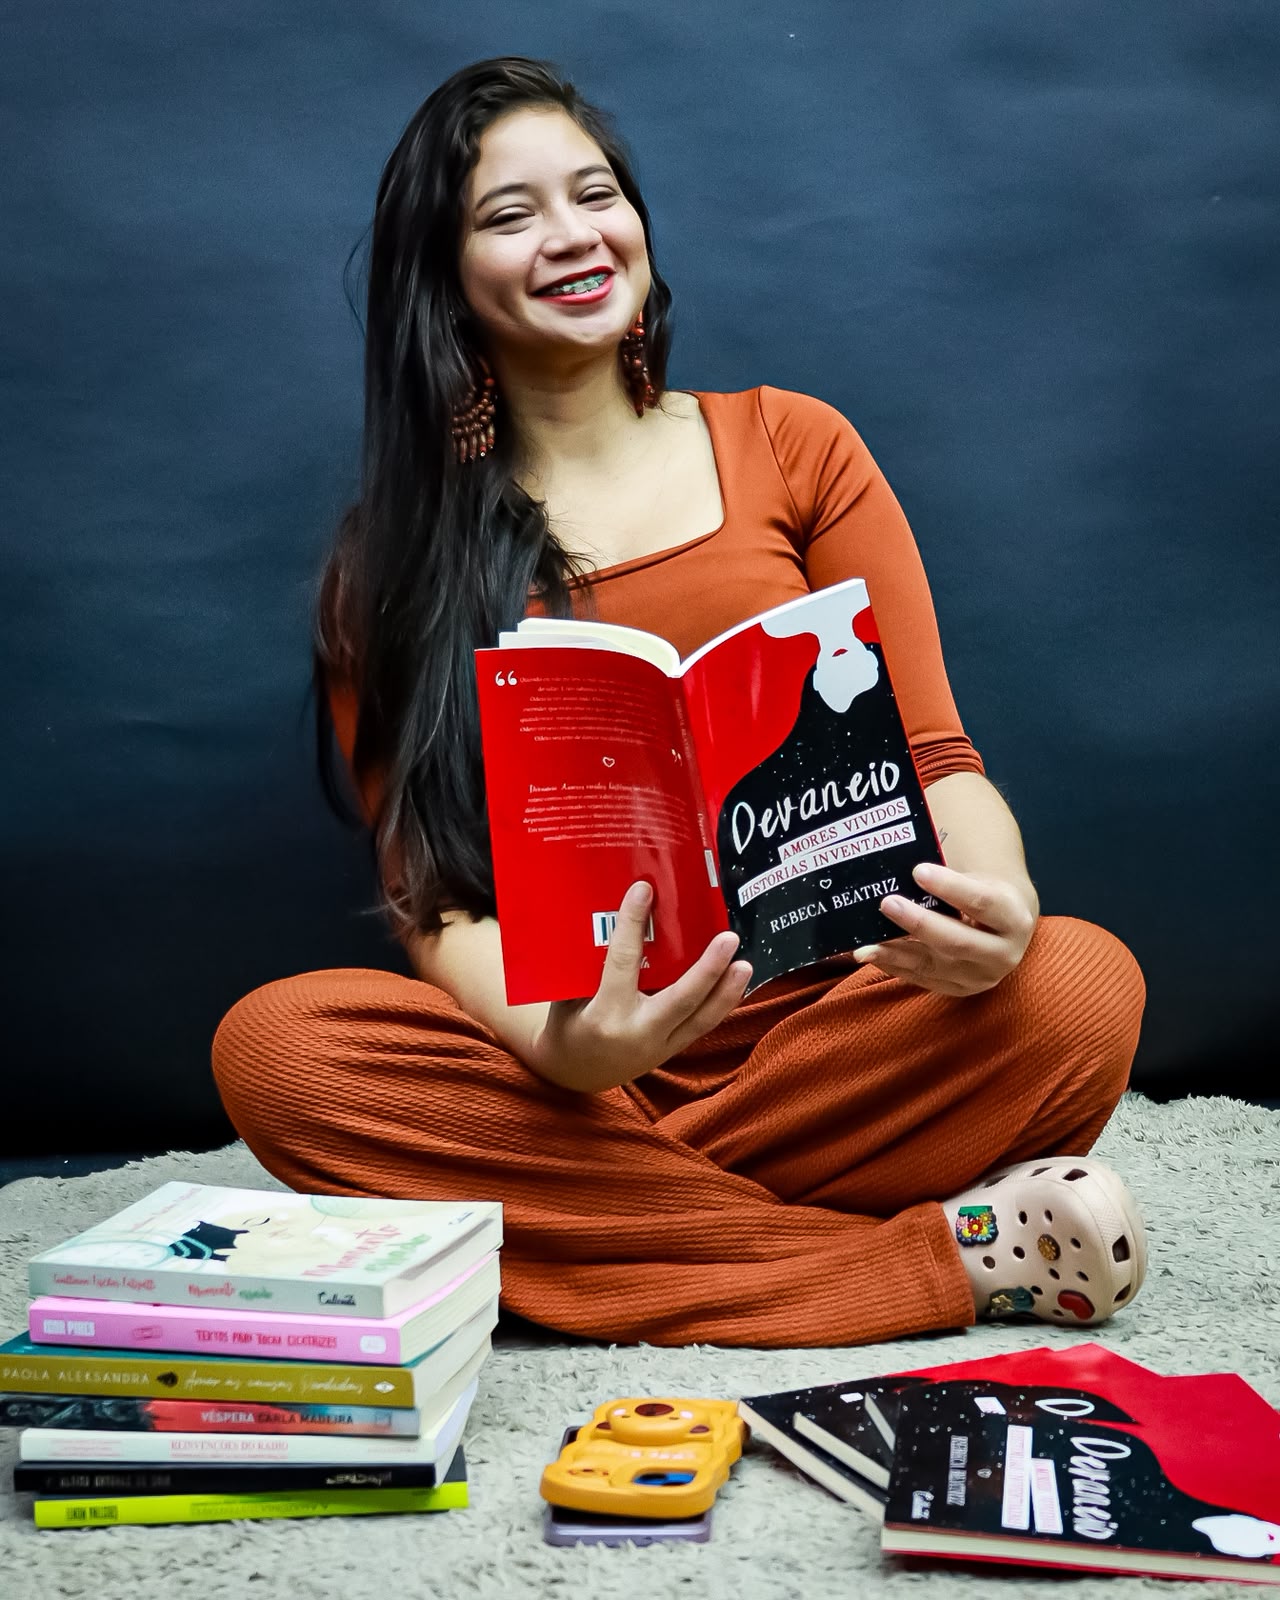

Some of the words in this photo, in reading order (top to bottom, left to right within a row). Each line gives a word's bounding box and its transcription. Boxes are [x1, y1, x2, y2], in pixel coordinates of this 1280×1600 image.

[732, 761, 900, 855] Devaneio
[783, 826, 838, 860] AMORES
[843, 800, 907, 834] VIVIDOS
[740, 860, 808, 902] HISTORIAS
[813, 826, 912, 867] INVENTADAS
[769, 901, 829, 934] REBECA
[831, 877, 900, 910] BEATRIZ
[3, 1368, 50, 1380] PAOLA
[58, 1370, 150, 1385] ALEKSANDRA
[259, 1412, 298, 1425] CARLA
[301, 1413, 354, 1425] MADEIRA
